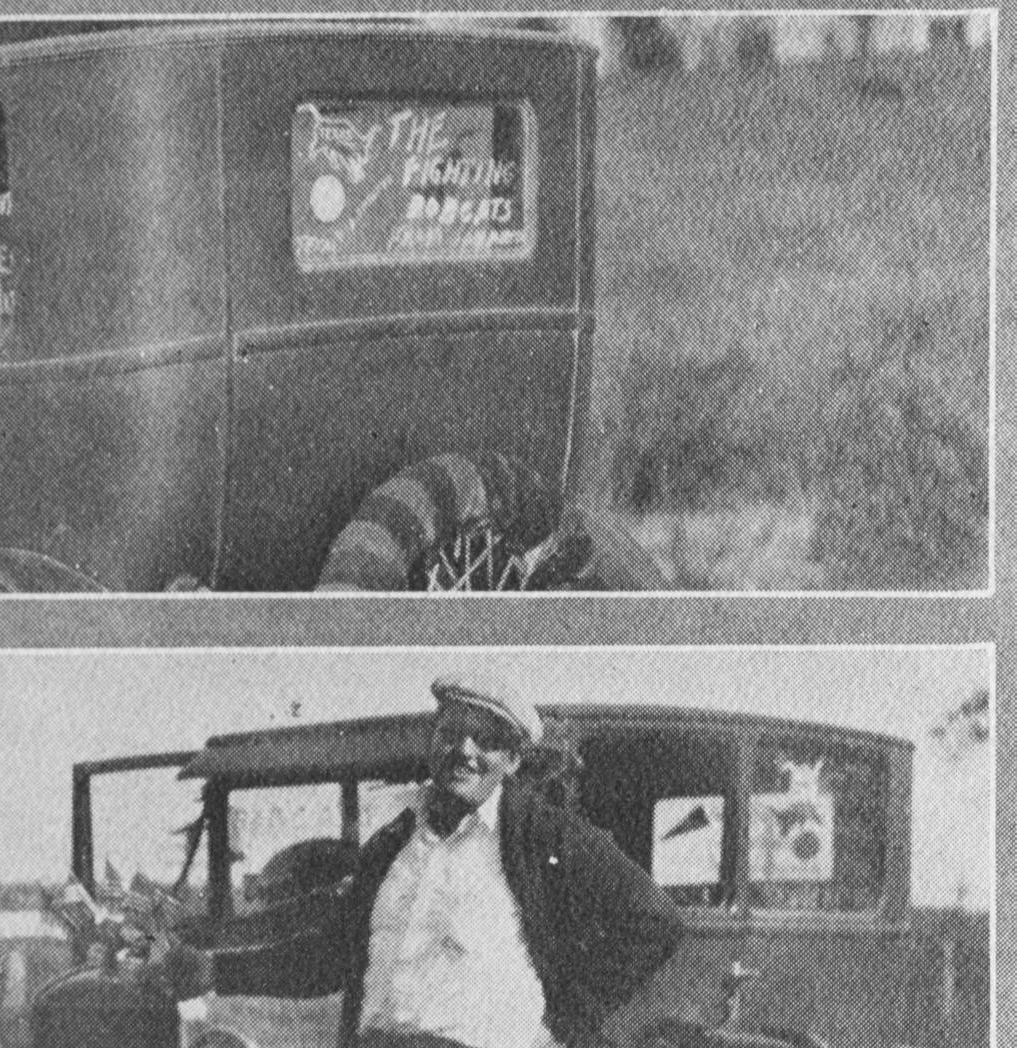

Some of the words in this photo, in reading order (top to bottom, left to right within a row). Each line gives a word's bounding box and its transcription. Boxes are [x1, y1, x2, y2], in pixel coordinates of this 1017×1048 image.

[389, 108, 450, 153] THE
[402, 155, 516, 187] FIGHTING
[405, 192, 513, 226] BOBCATS
